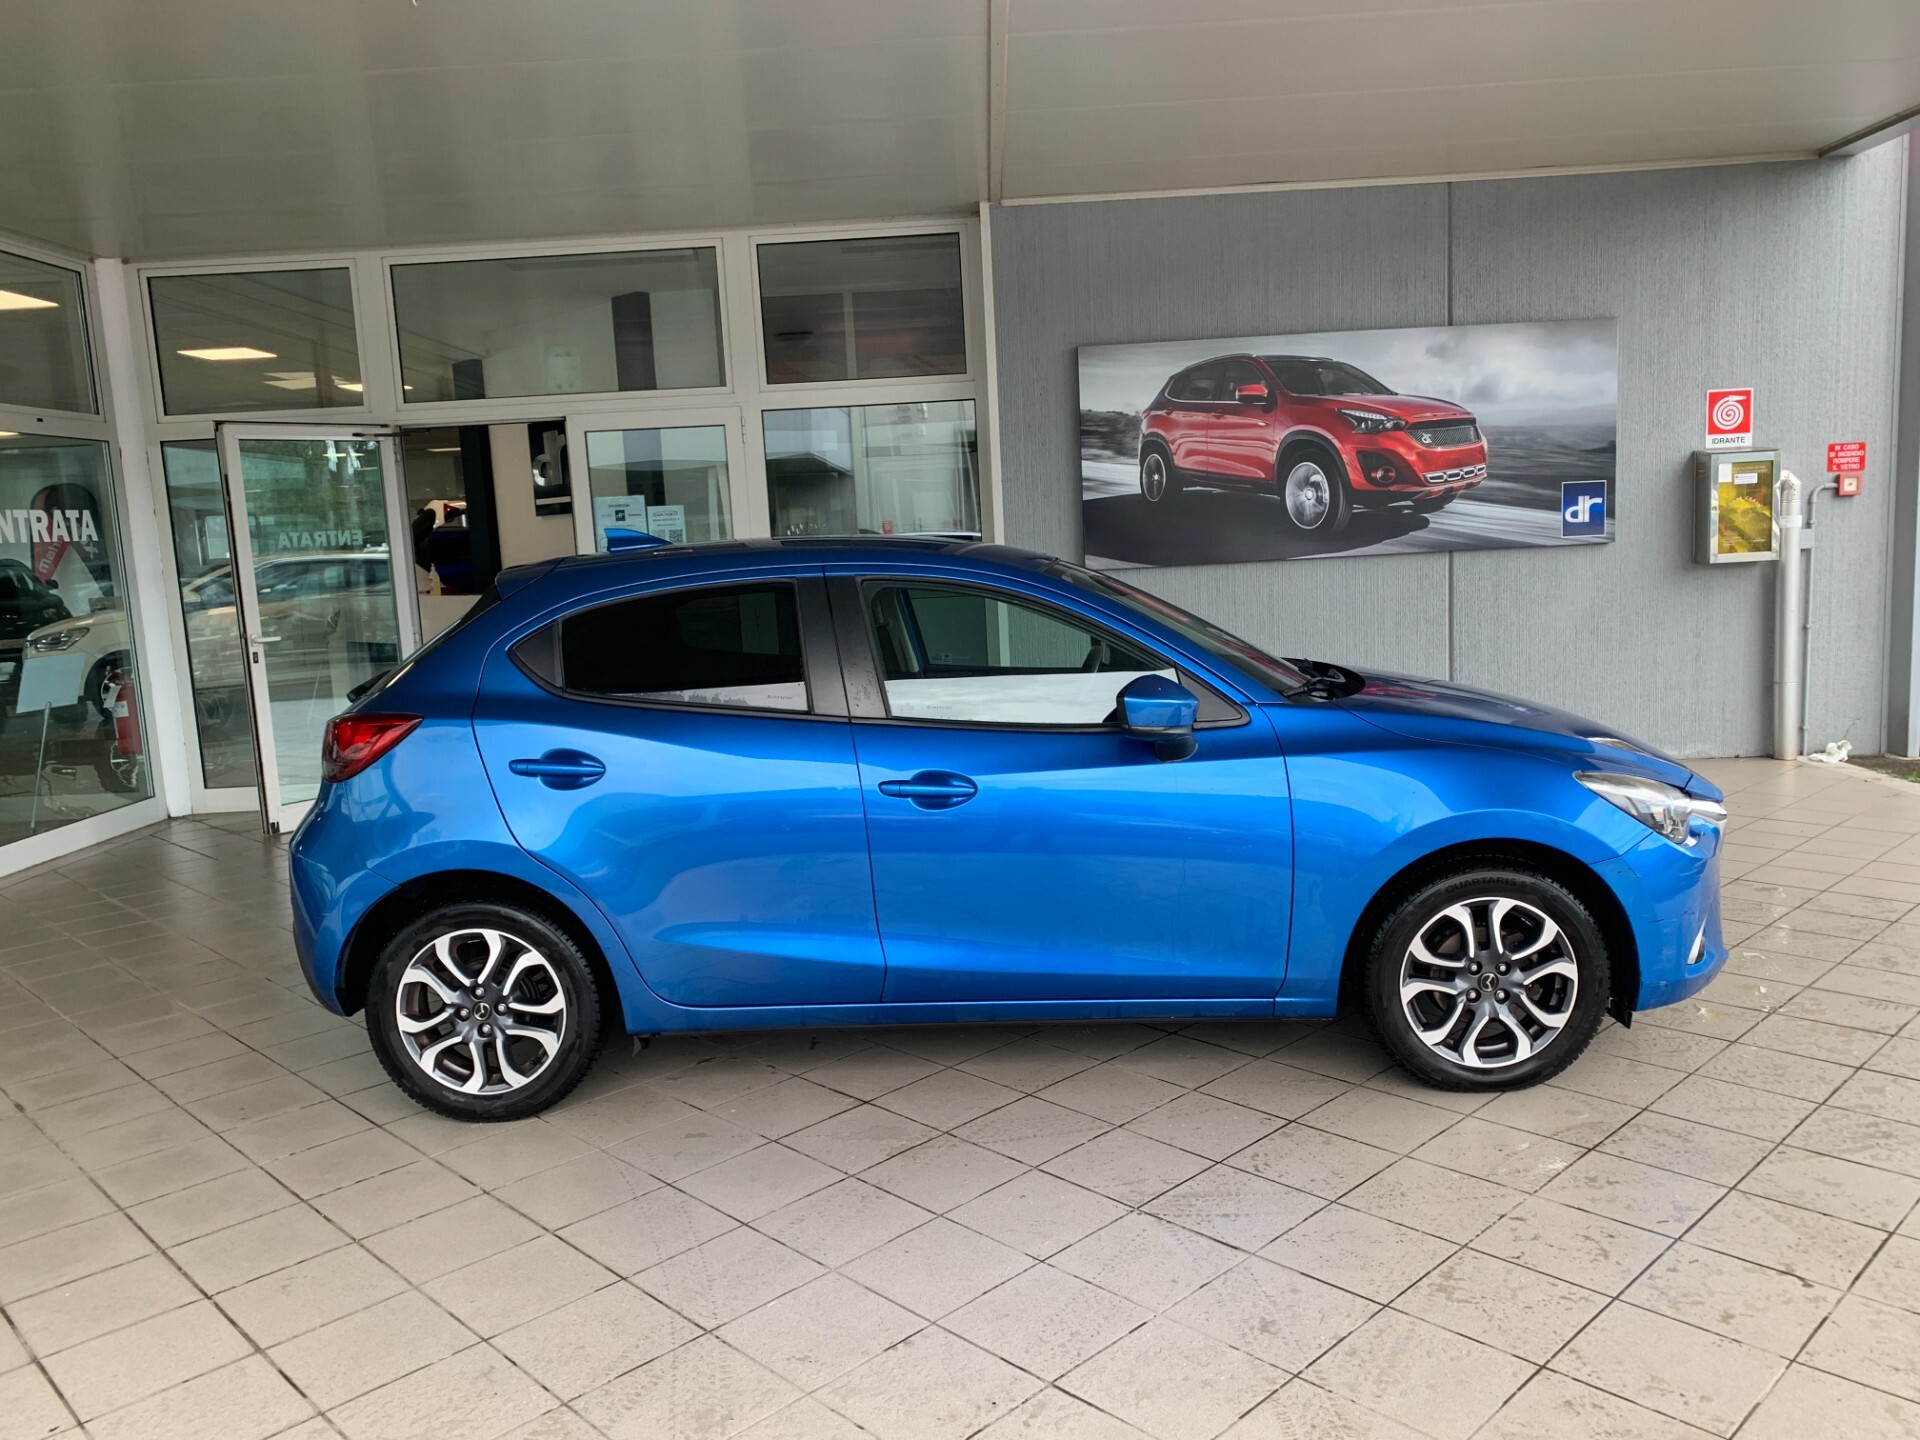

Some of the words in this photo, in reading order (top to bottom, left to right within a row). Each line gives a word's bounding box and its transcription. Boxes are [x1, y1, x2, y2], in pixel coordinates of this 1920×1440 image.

[1711, 436, 1746, 445] IDRANTE
[1565, 495, 1603, 523] dr
[0, 509, 99, 543] NTRATA
[1445, 876, 1517, 893] QUARTARIS
